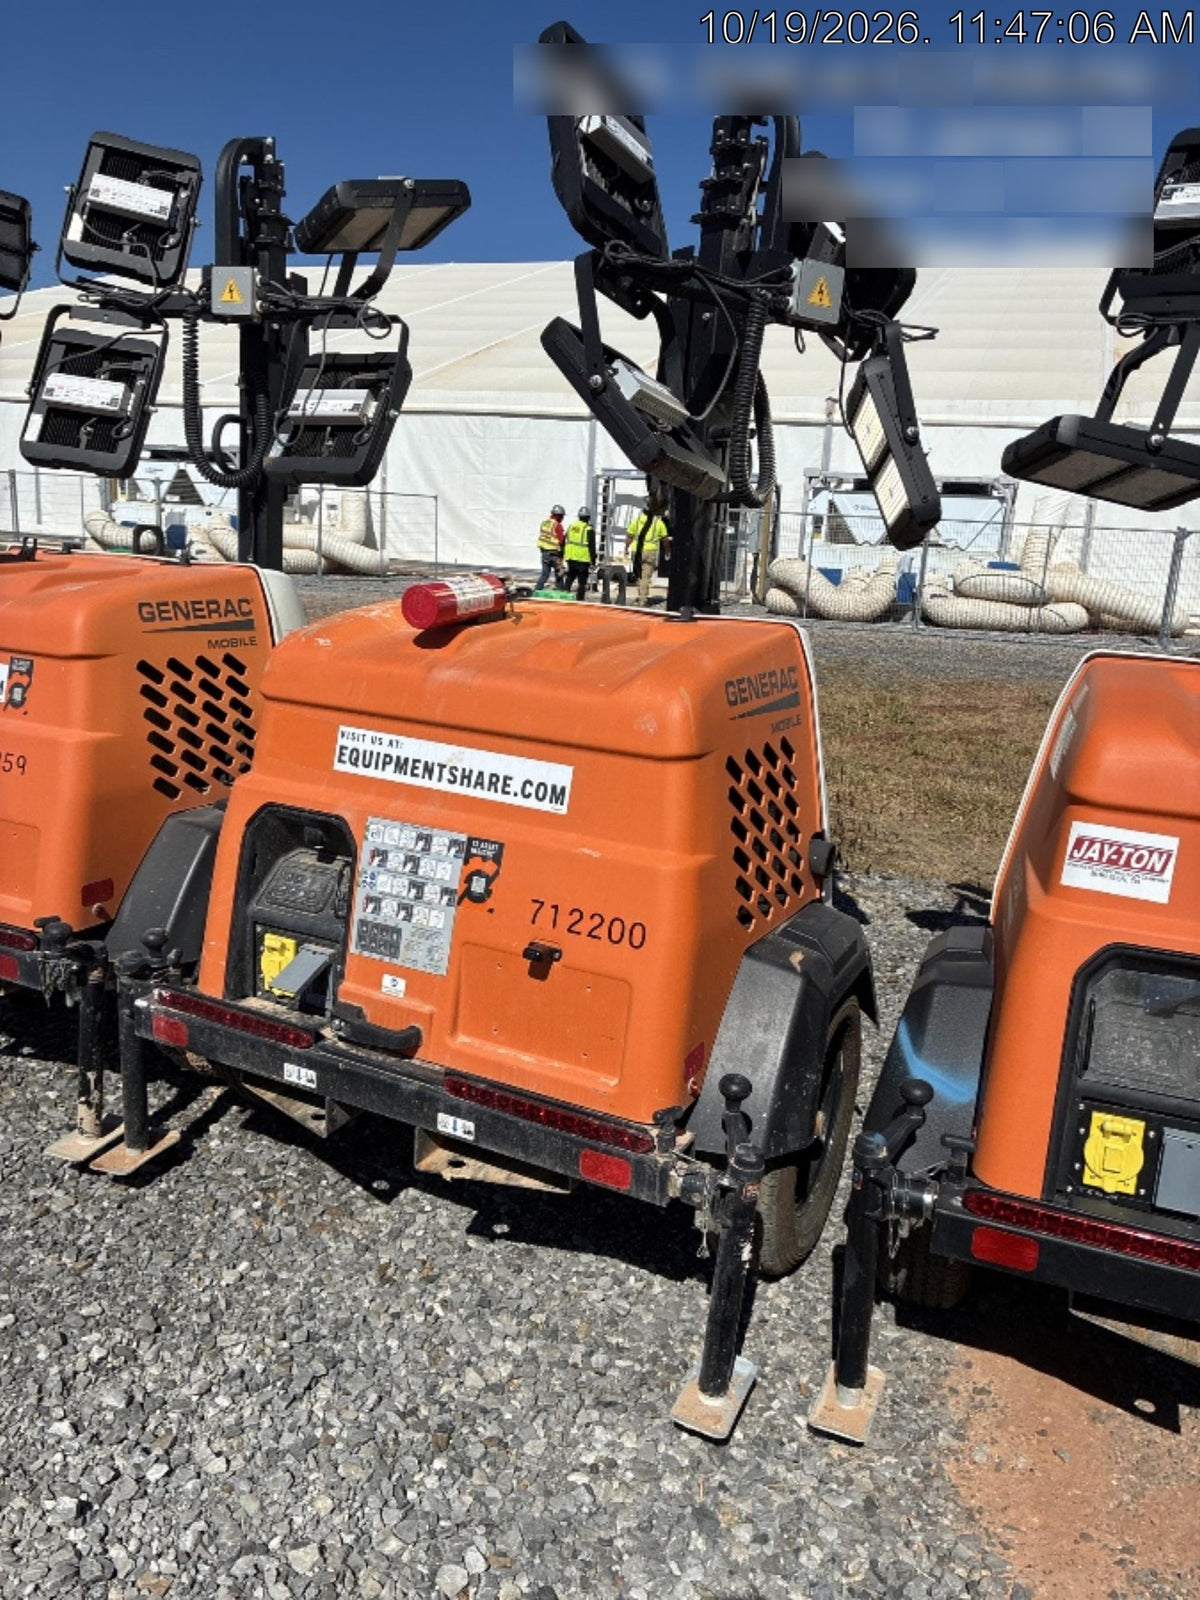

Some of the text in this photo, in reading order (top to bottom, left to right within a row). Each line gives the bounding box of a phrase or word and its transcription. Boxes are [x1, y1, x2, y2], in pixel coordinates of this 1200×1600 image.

[138, 598, 253, 623] GENERAC
[207, 636, 257, 649] MOBILE
[725, 666, 798, 707] GENERAC
[341, 730, 366, 743] VISIT
[371, 736, 383, 745] US
[337, 745, 567, 806] EQUIPMENTSHARE.COM
[1072, 840, 1168, 873] JAY-TON
[531, 899, 646, 950] 712200
